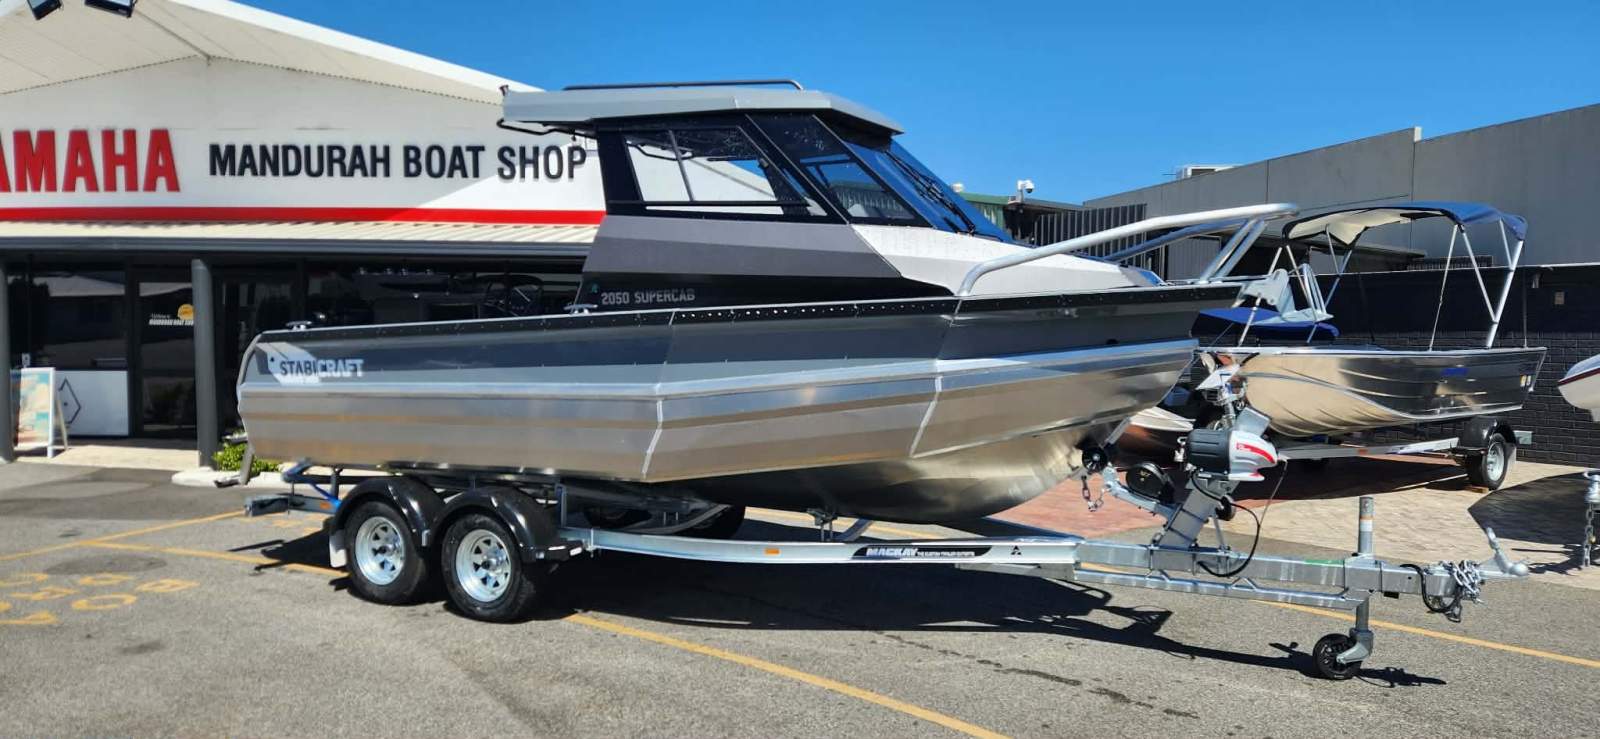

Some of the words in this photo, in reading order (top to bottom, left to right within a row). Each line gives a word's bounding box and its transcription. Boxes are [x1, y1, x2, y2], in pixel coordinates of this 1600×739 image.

[208, 143, 390, 179] MANDURAH
[402, 145, 486, 179] BOAT
[496, 145, 587, 180] SHOP
[601, 291, 630, 305] 2050
[634, 288, 696, 304] SUPERCAB
[279, 359, 365, 378] STABICRAFT
[866, 547, 919, 557] MACKAY
